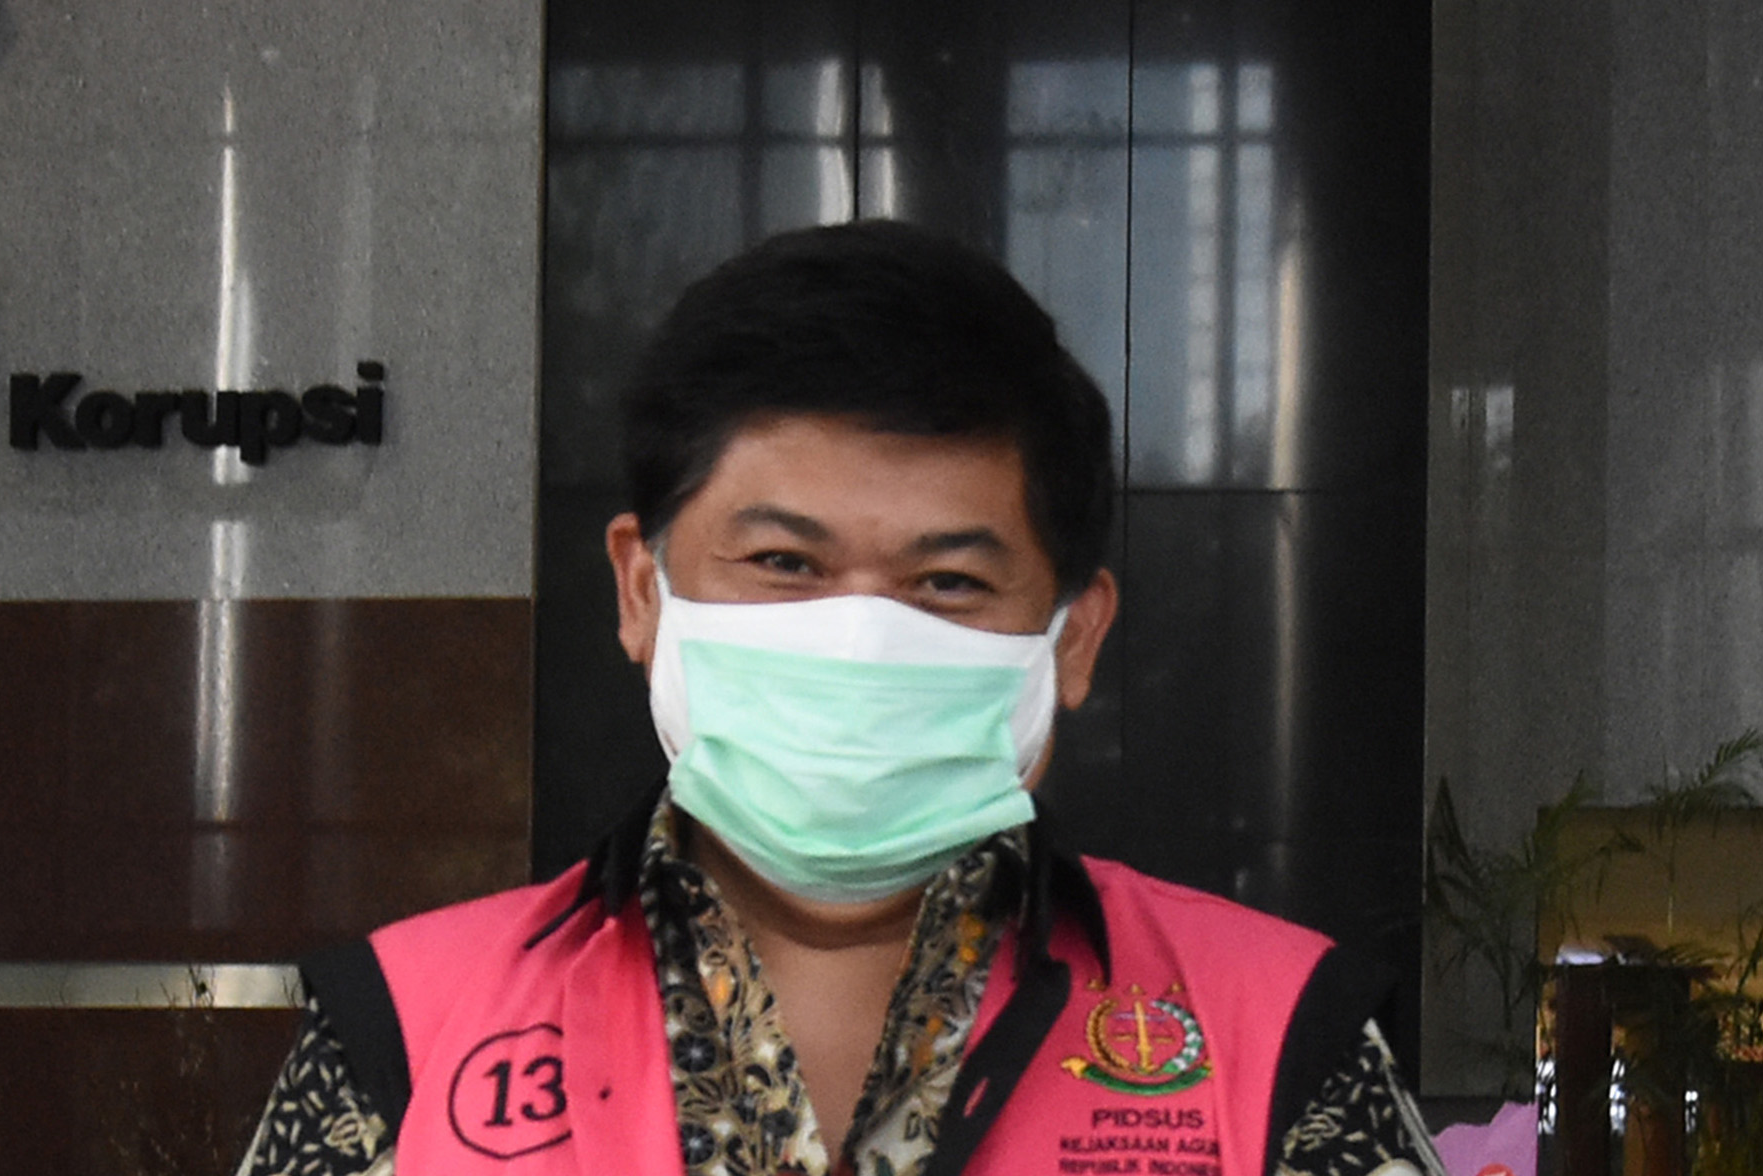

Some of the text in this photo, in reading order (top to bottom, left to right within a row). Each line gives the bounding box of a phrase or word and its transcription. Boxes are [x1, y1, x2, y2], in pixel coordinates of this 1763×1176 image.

[9, 360, 385, 466] Korupsi
[483, 1055, 568, 1127] 13
[1092, 1108, 1205, 1130] PIDSUS
